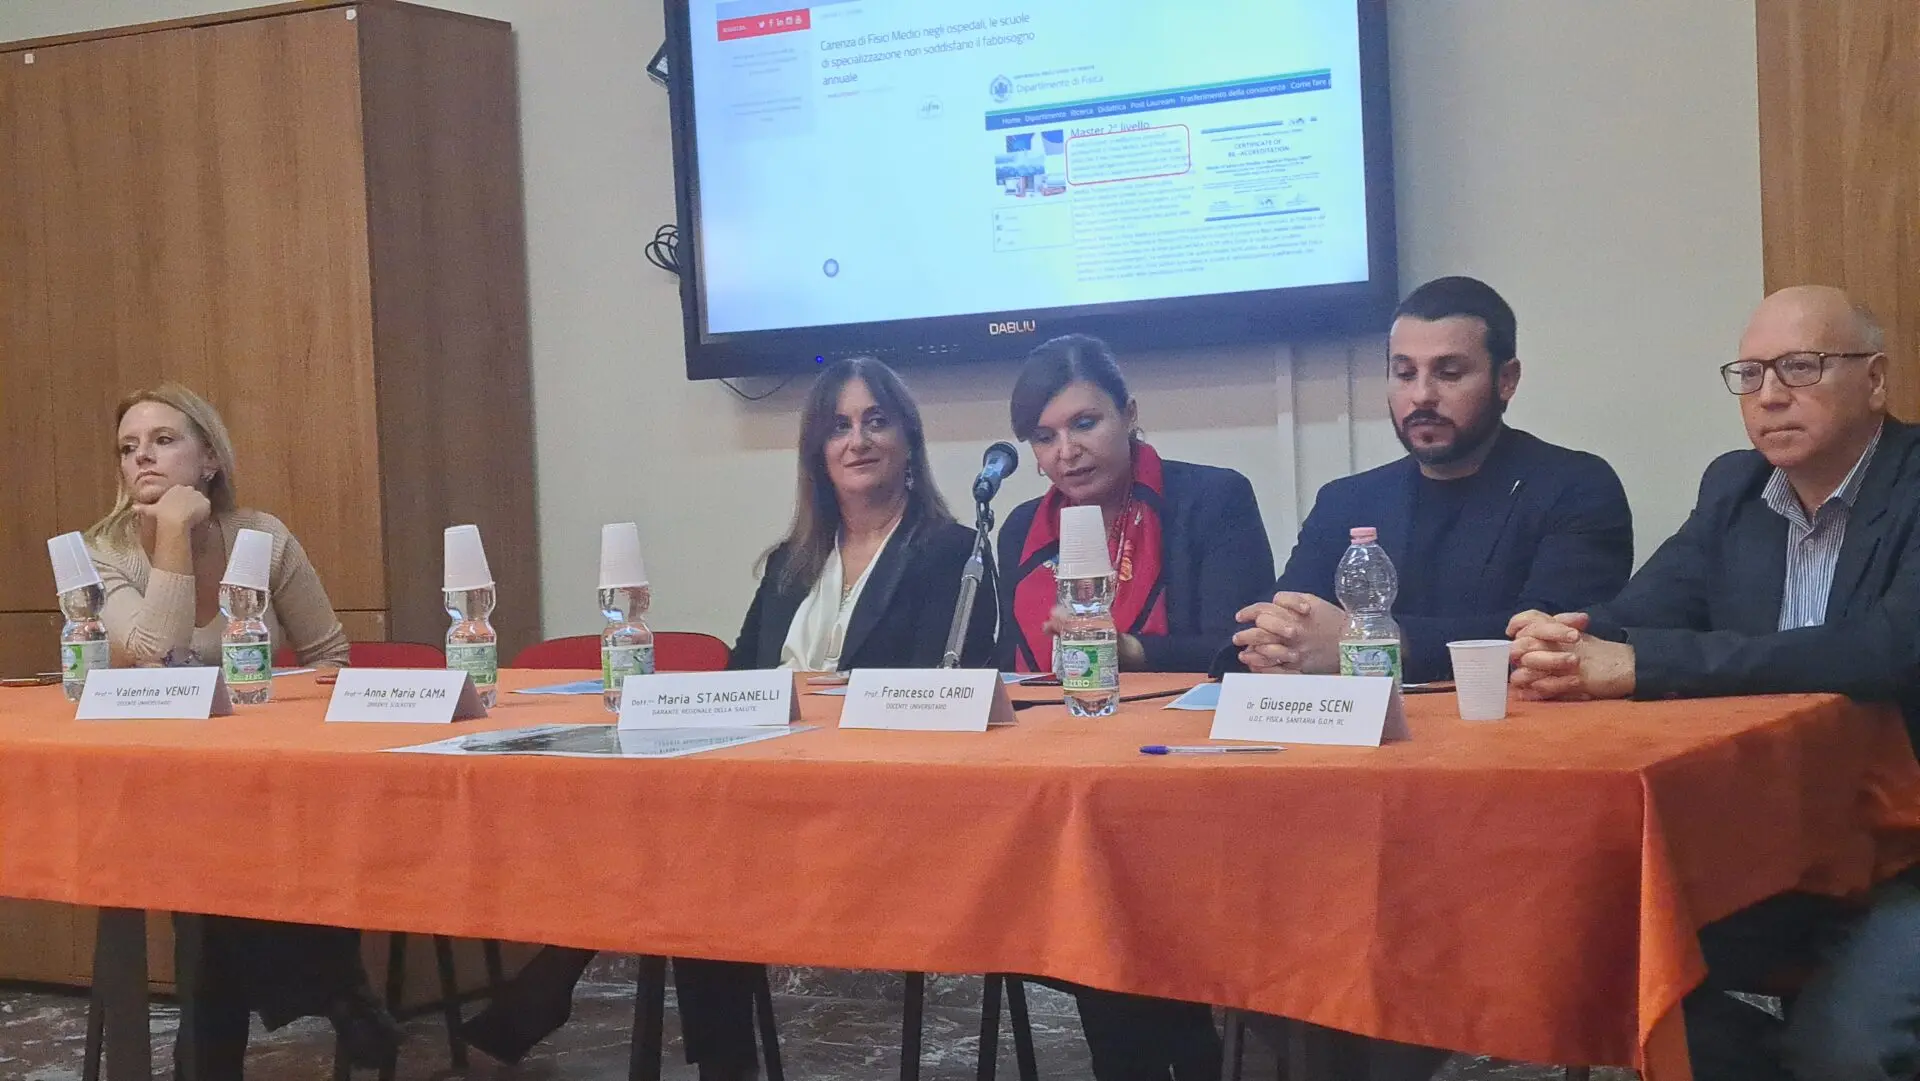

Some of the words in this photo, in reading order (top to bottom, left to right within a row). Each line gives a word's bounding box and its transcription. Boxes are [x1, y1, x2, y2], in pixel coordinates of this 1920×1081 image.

[820, 38, 857, 52] Carenza
[858, 35, 866, 48] di
[891, 27, 921, 42] Medici
[922, 24, 945, 39] negli
[946, 20, 988, 36] ospedali,
[989, 17, 998, 29] le
[999, 12, 1030, 27] scuole
[821, 56, 830, 69] di
[831, 50, 901, 70] specializzazione
[903, 46, 922, 58] non
[923, 38, 974, 56] soddisfano
[975, 36, 981, 47] il
[982, 30, 1036, 49] fabbisogno
[822, 73, 858, 86] annuale
[1016, 79, 1071, 95] Dipartimento
[1072, 77, 1080, 87] di
[1081, 74, 1104, 85] Fisica
[1002, 116, 1021, 126] Home
[1025, 110, 1067, 124] Dipartimento
[1070, 106, 1094, 117] Ricerca
[1097, 102, 1127, 114] Didattica
[1130, 99, 1145, 109] Post
[1145, 97, 1176, 108] Lauream
[1180, 91, 1227, 105] Trasferimento
[1227, 88, 1245, 98] della
[1246, 84, 1286, 96] conoscenza
[1290, 80, 1310, 90] Come
[1311, 78, 1327, 88] fare
[1070, 125, 1104, 138] Master
[1119, 120, 1150, 133] livello
[989, 320, 1036, 336] DABLIU
[116, 687, 160, 697] Valentina
[165, 686, 200, 697] VENUTI
[1069, 680, 1090, 688] ZERO
[364, 688, 387, 698] Anna
[390, 688, 415, 698] Maria
[419, 688, 446, 698] CAMA
[657, 694, 690, 705] Maria
[696, 690, 780, 703] STANGANELLI
[881, 687, 934, 698] Francesco
[939, 687, 975, 698] CARIDI
[1259, 697, 1313, 714] Giuseppe
[1319, 699, 1354, 713] SCENI
